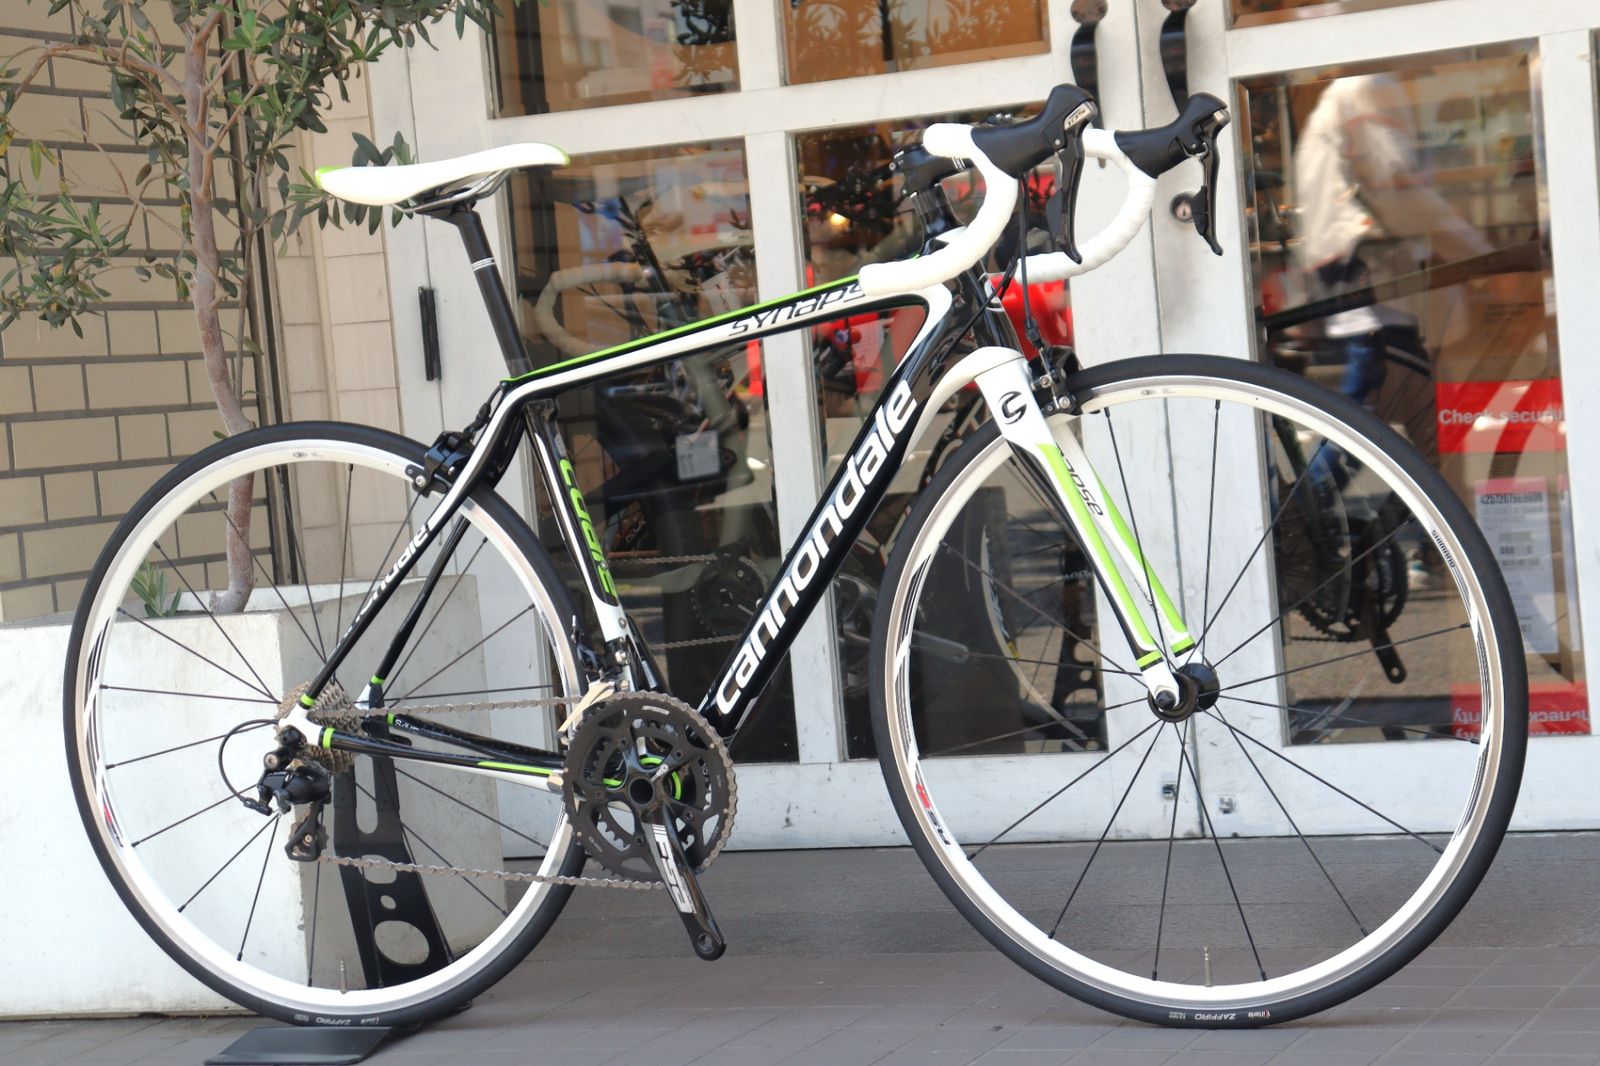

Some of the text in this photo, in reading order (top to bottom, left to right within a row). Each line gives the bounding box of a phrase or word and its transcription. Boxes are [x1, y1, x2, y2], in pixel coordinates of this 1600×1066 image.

[715, 379, 918, 715] cannondale
[1431, 529, 1456, 568] SHIMANO
[1194, 1012, 1237, 1021] ZAFFIRO
